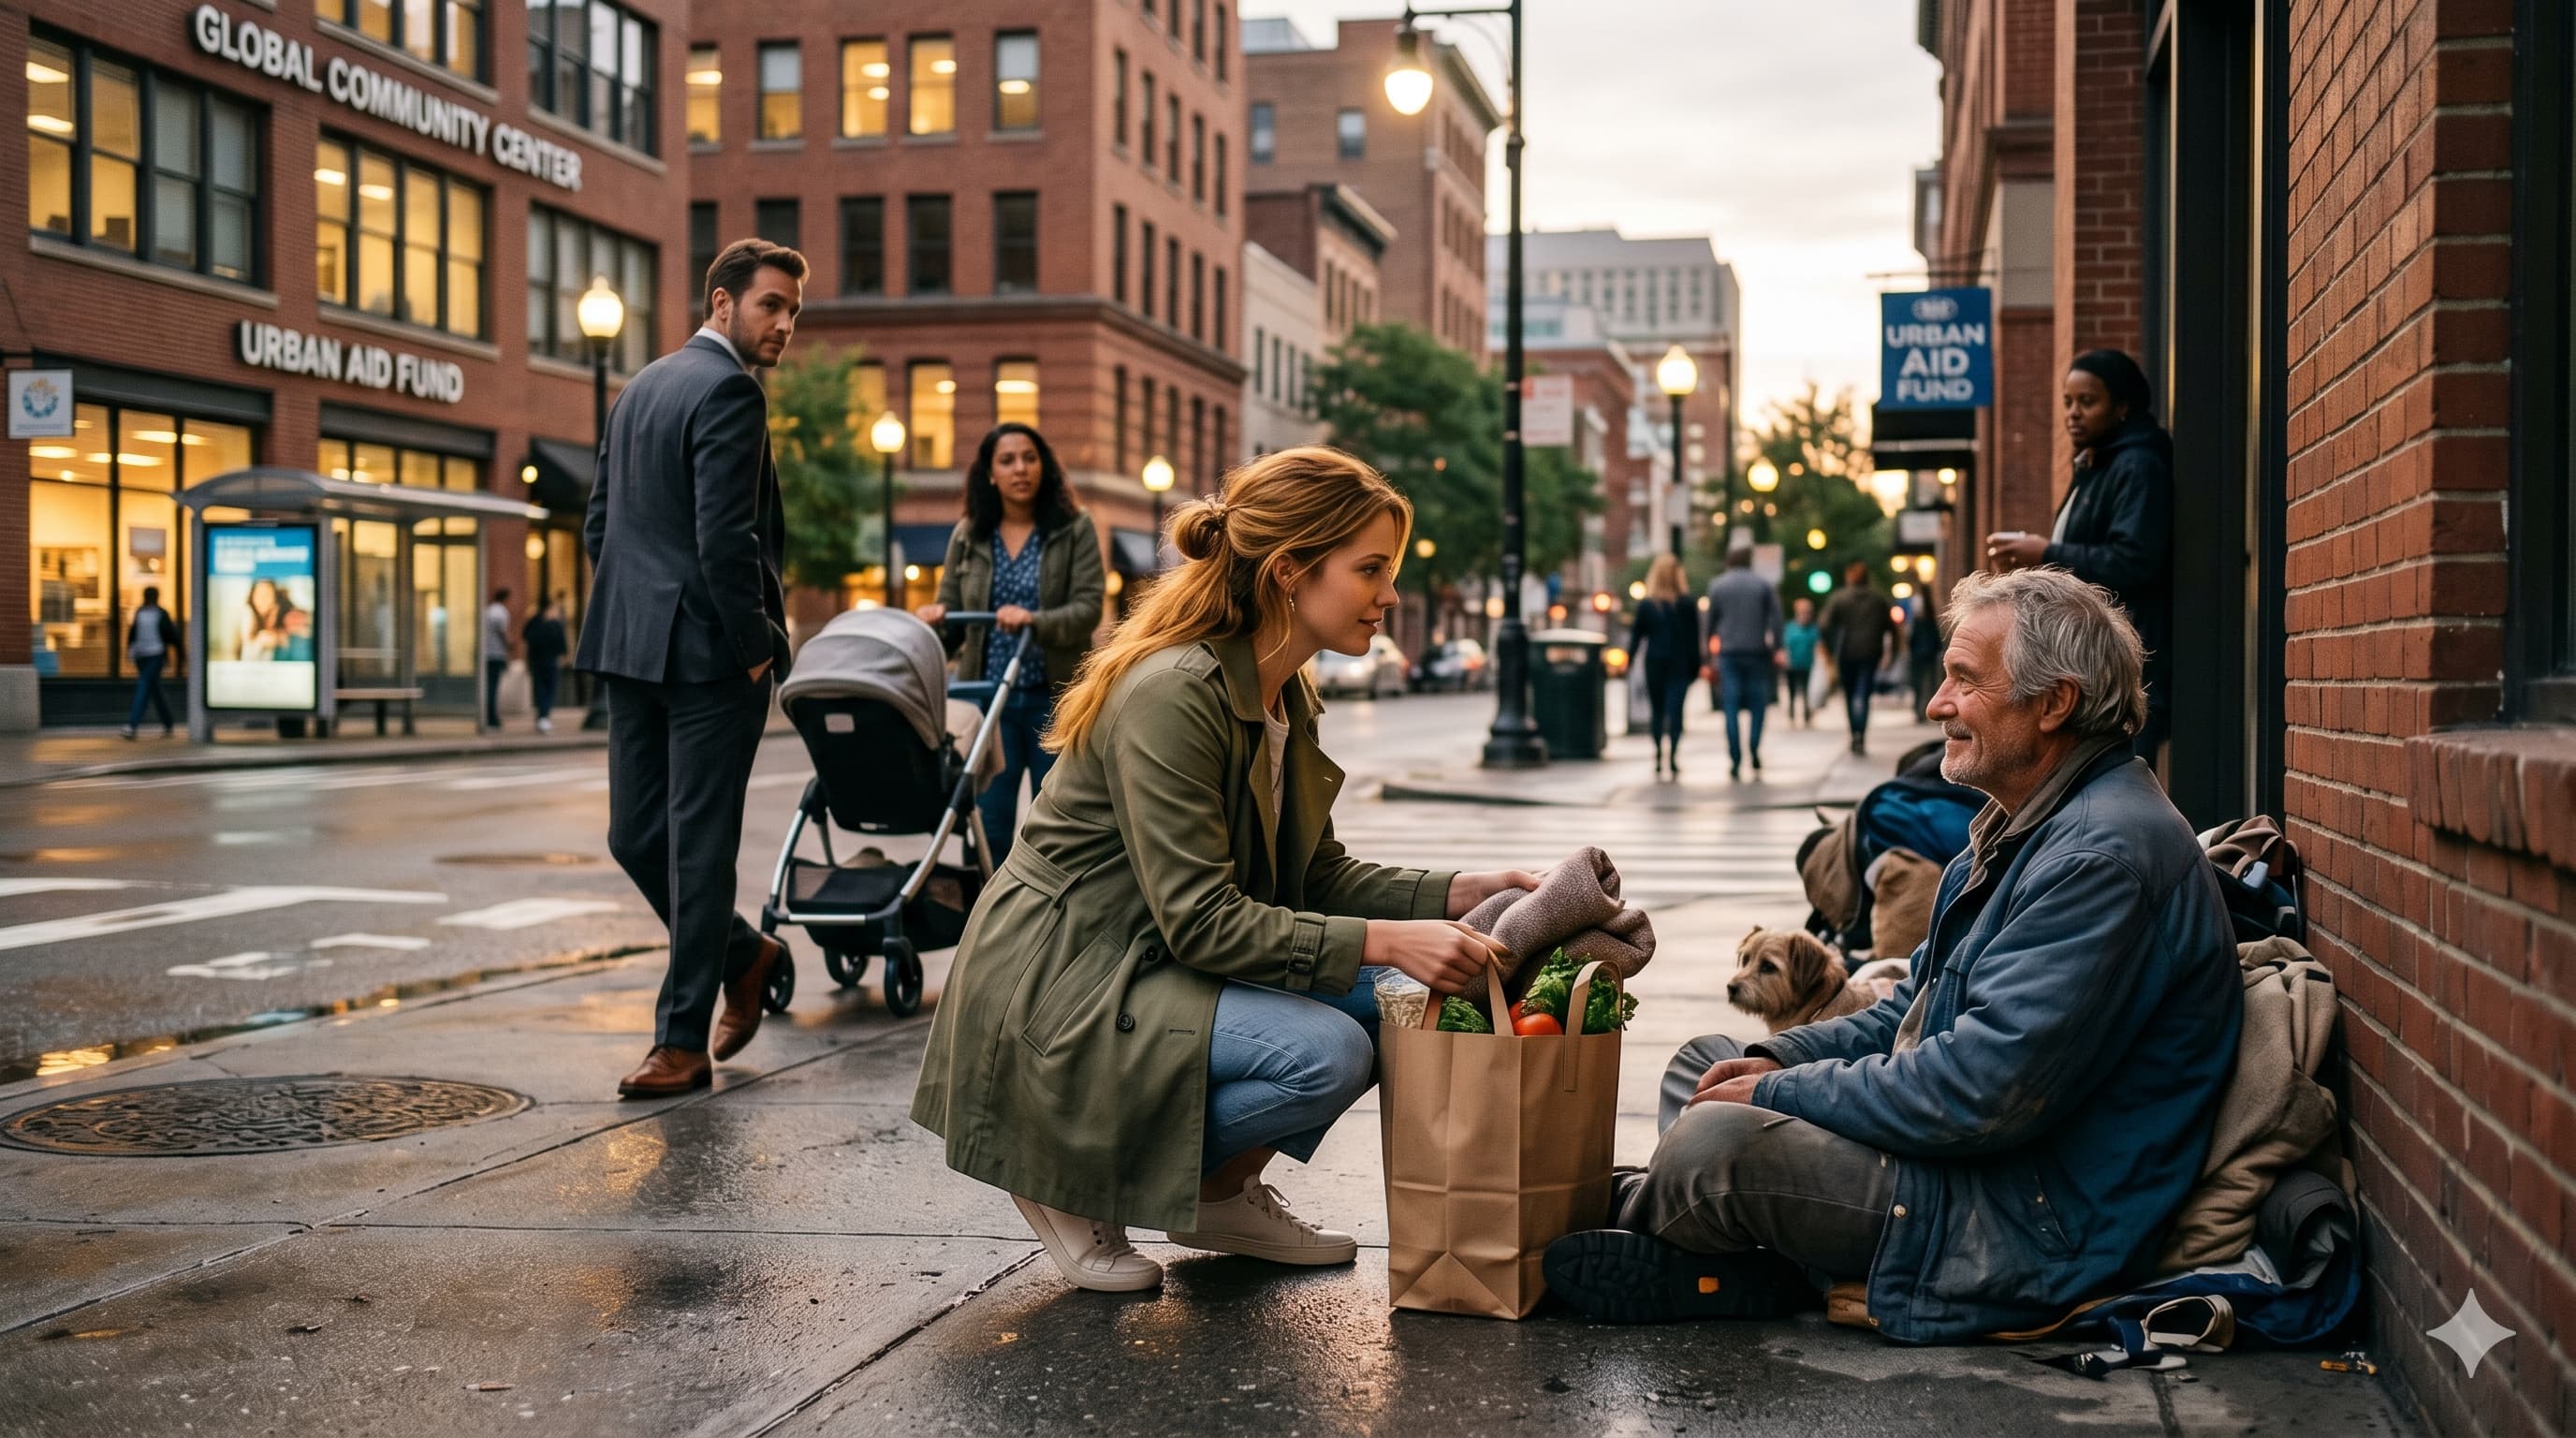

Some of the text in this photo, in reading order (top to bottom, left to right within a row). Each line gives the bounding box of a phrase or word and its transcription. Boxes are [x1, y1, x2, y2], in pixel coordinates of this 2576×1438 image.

[195, 4, 584, 193] GLOBAL COMMUNITY CENTER
[1886, 321, 1986, 348] URBAN
[240, 319, 465, 404] URBAN AID FUND
[1899, 347, 1970, 377] AID
[1896, 376, 1974, 403] FUND
